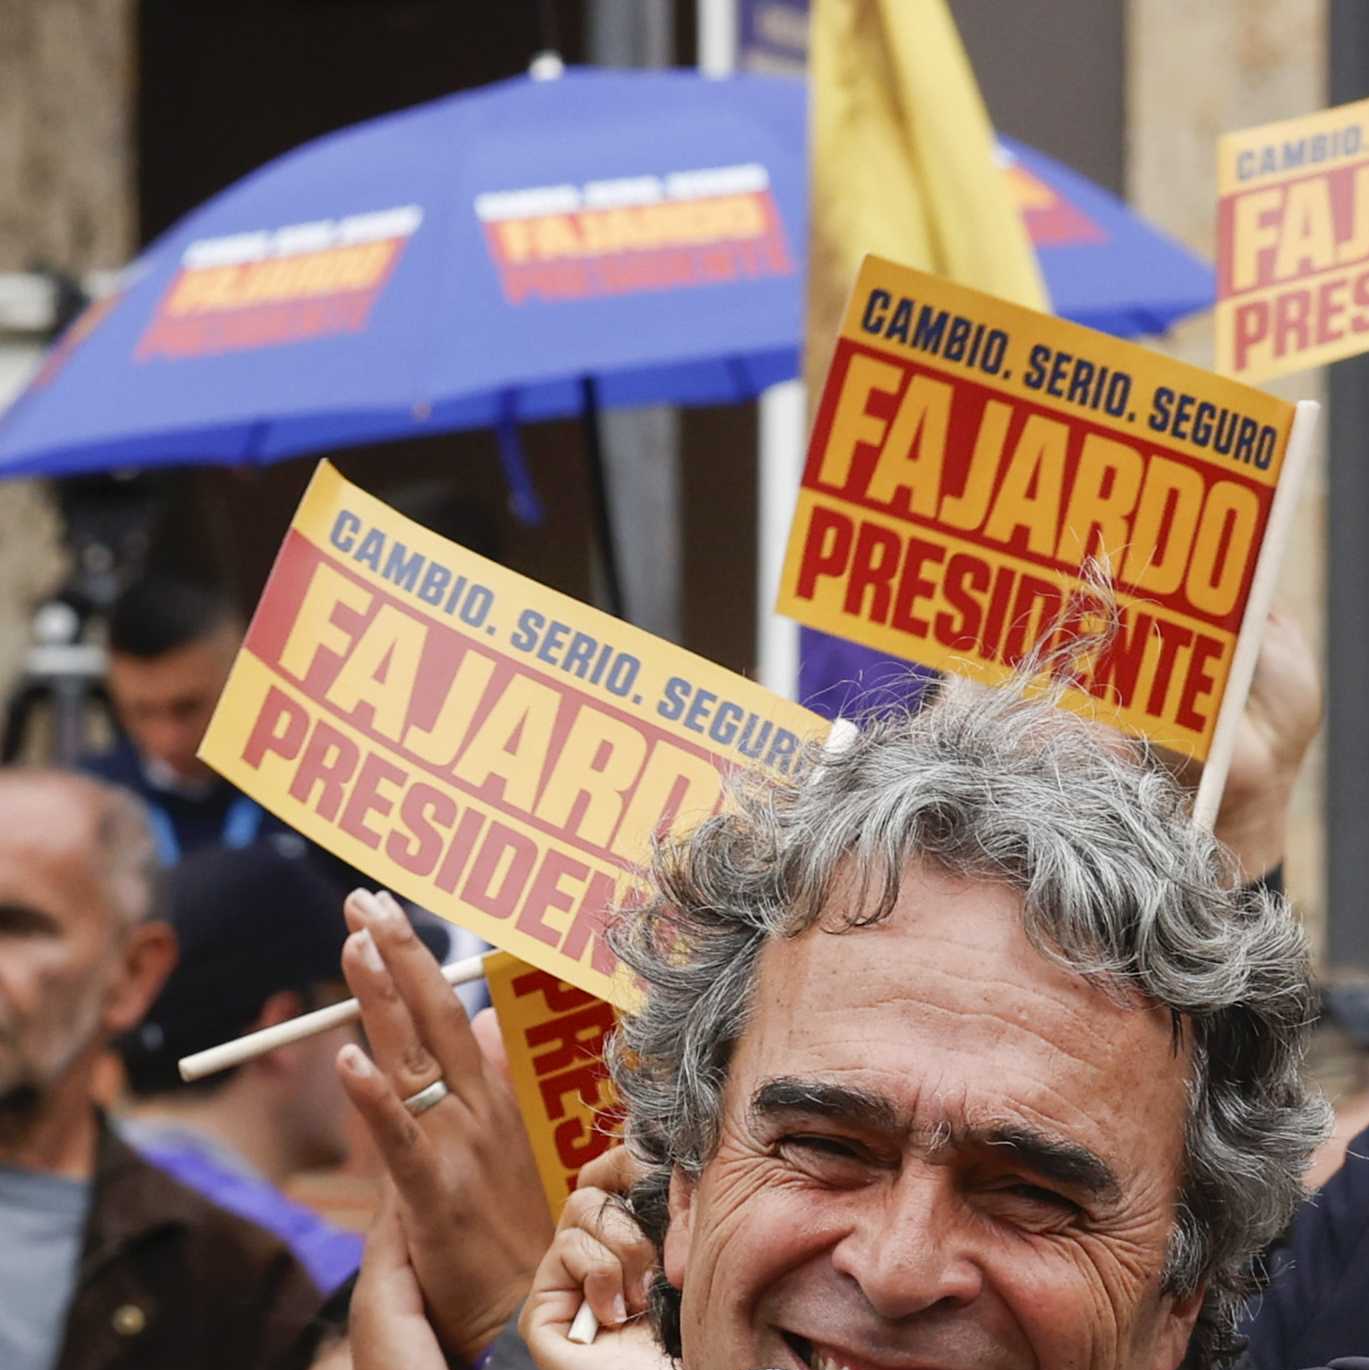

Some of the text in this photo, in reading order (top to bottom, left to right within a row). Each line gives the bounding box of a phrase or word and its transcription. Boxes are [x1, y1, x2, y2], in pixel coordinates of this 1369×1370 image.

[817, 352, 1261, 618] FAJARDO
[861, 288, 1278, 471] CAMBIO. SERIO. SEGURO
[277, 561, 727, 869] FAJARD
[330, 508, 806, 779] CAMBIO. SERIO. SEGUR
[795, 504, 1226, 734] PRESIDENTE
[240, 684, 650, 986] PRESIDEN
